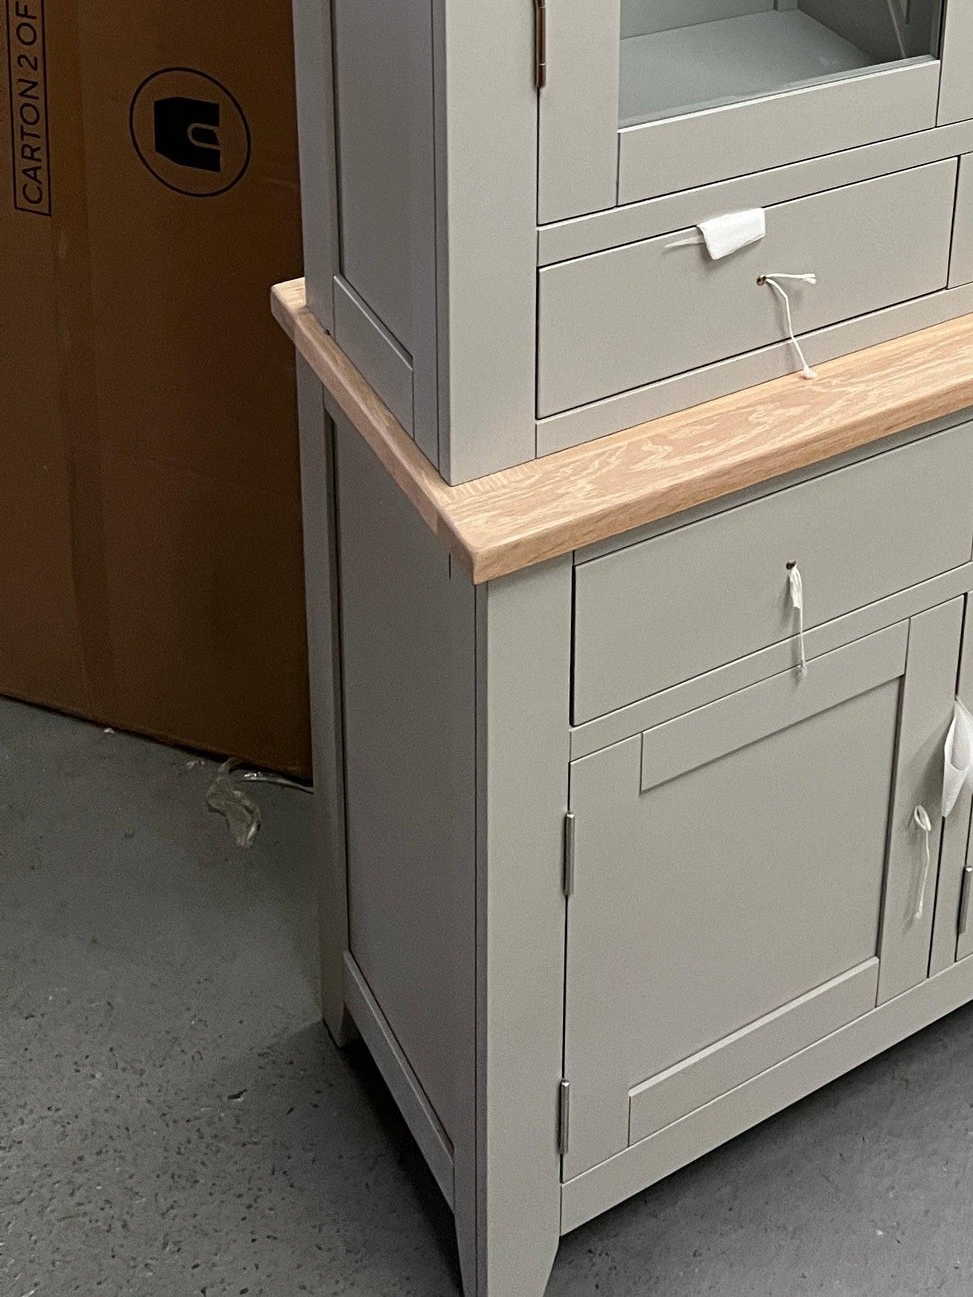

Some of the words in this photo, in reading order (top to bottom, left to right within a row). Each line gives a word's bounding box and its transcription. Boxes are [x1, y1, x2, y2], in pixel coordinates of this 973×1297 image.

[15, 1, 37, 46] OF
[17, 54, 38, 72] 2
[17, 78, 43, 205] CARTON
